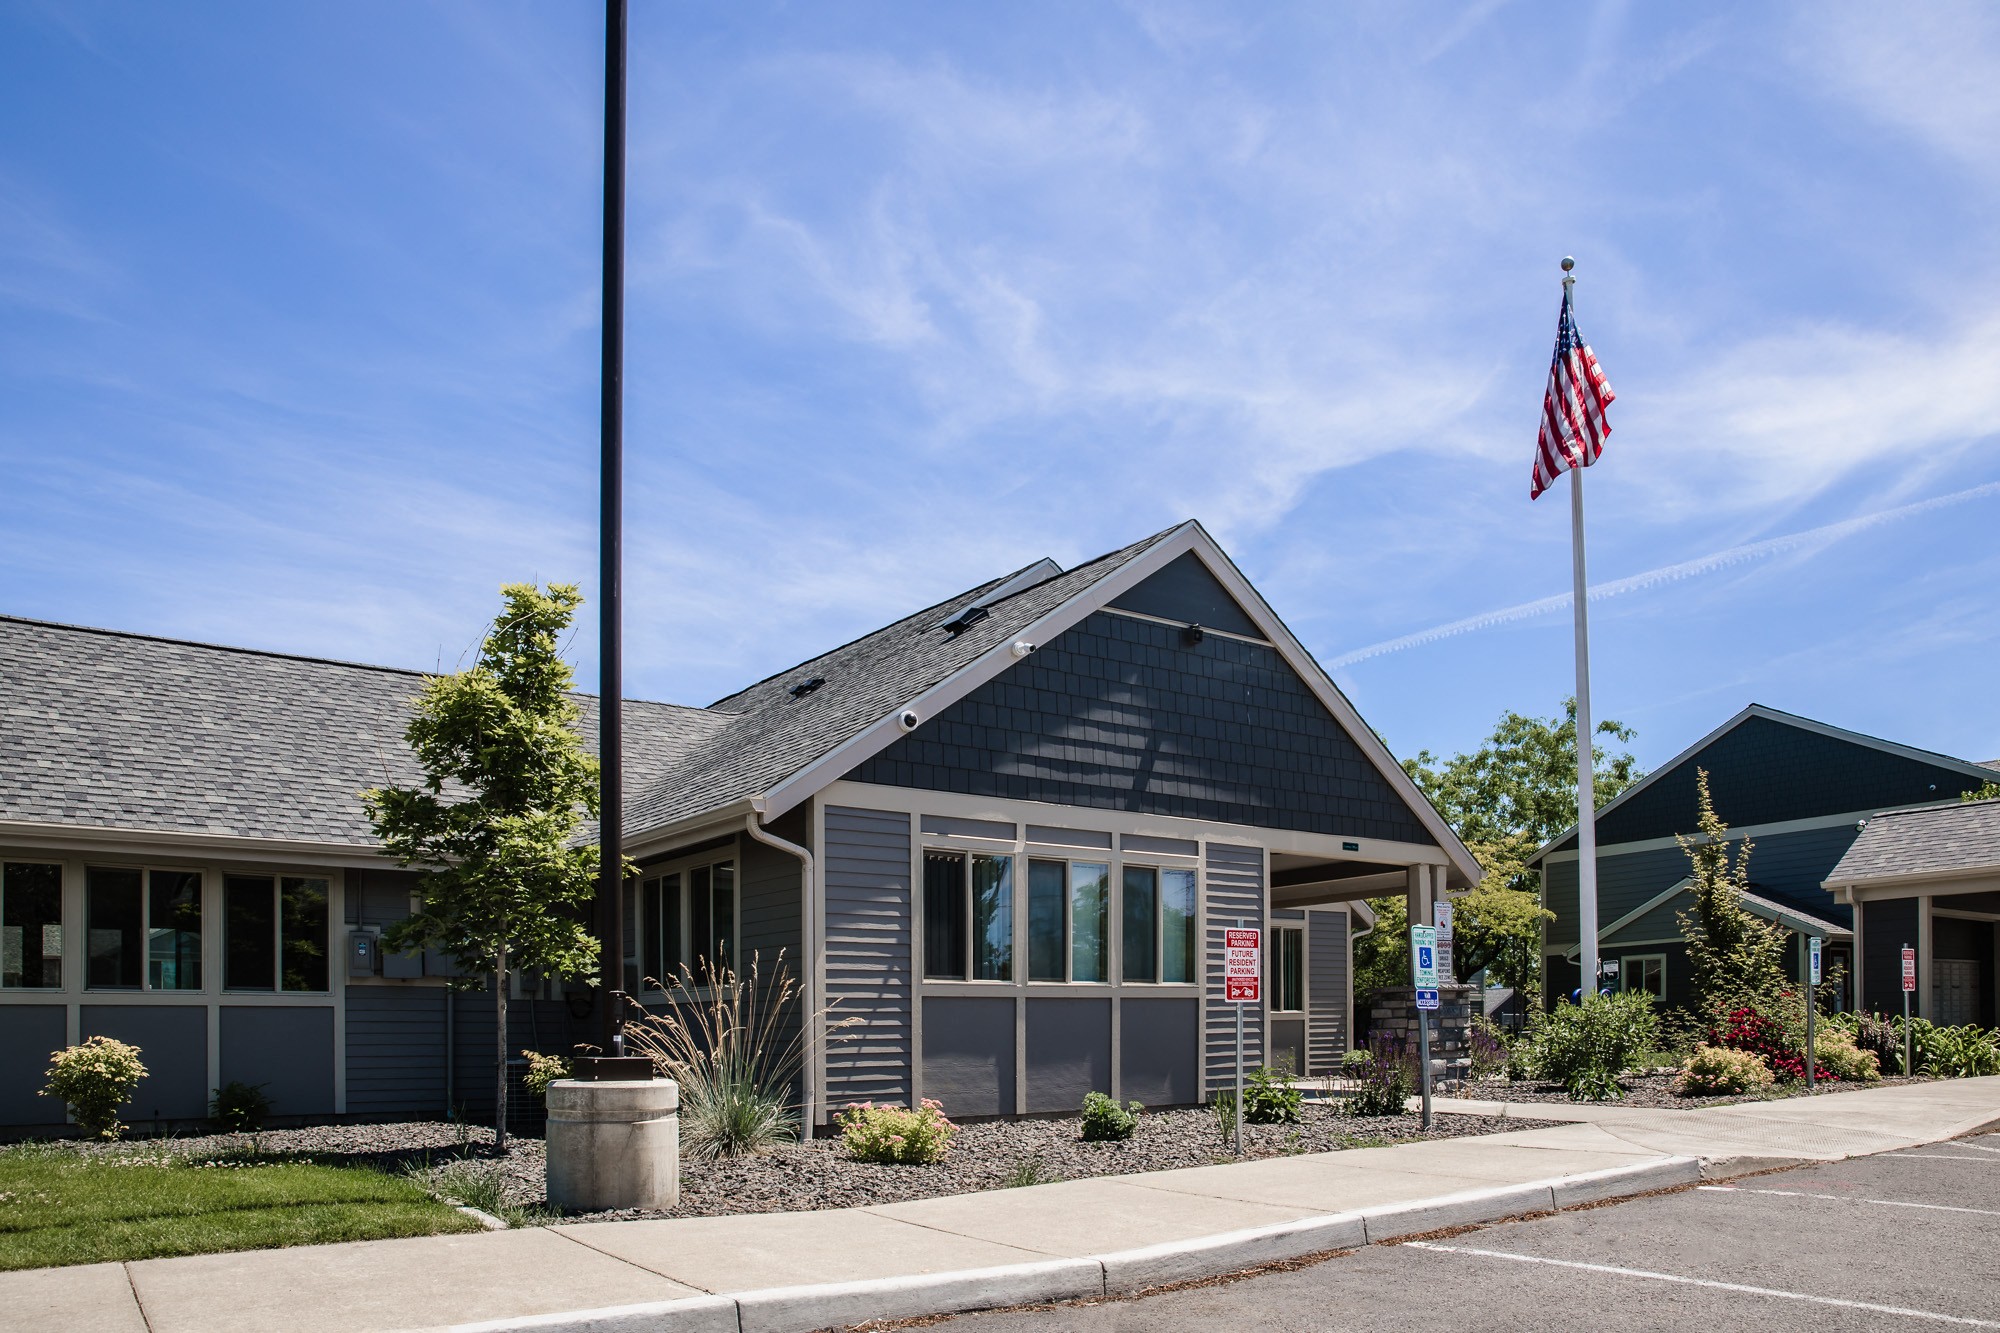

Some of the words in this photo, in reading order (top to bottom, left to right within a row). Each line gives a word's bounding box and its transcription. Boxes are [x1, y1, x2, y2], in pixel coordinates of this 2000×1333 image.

[1228, 931, 1257, 940] RESERVED
[1230, 939, 1255, 947] PARKING
[1231, 950, 1254, 958] FUTURE
[1228, 959, 1257, 967] RESIDENT
[1230, 967, 1255, 975] PARKING
